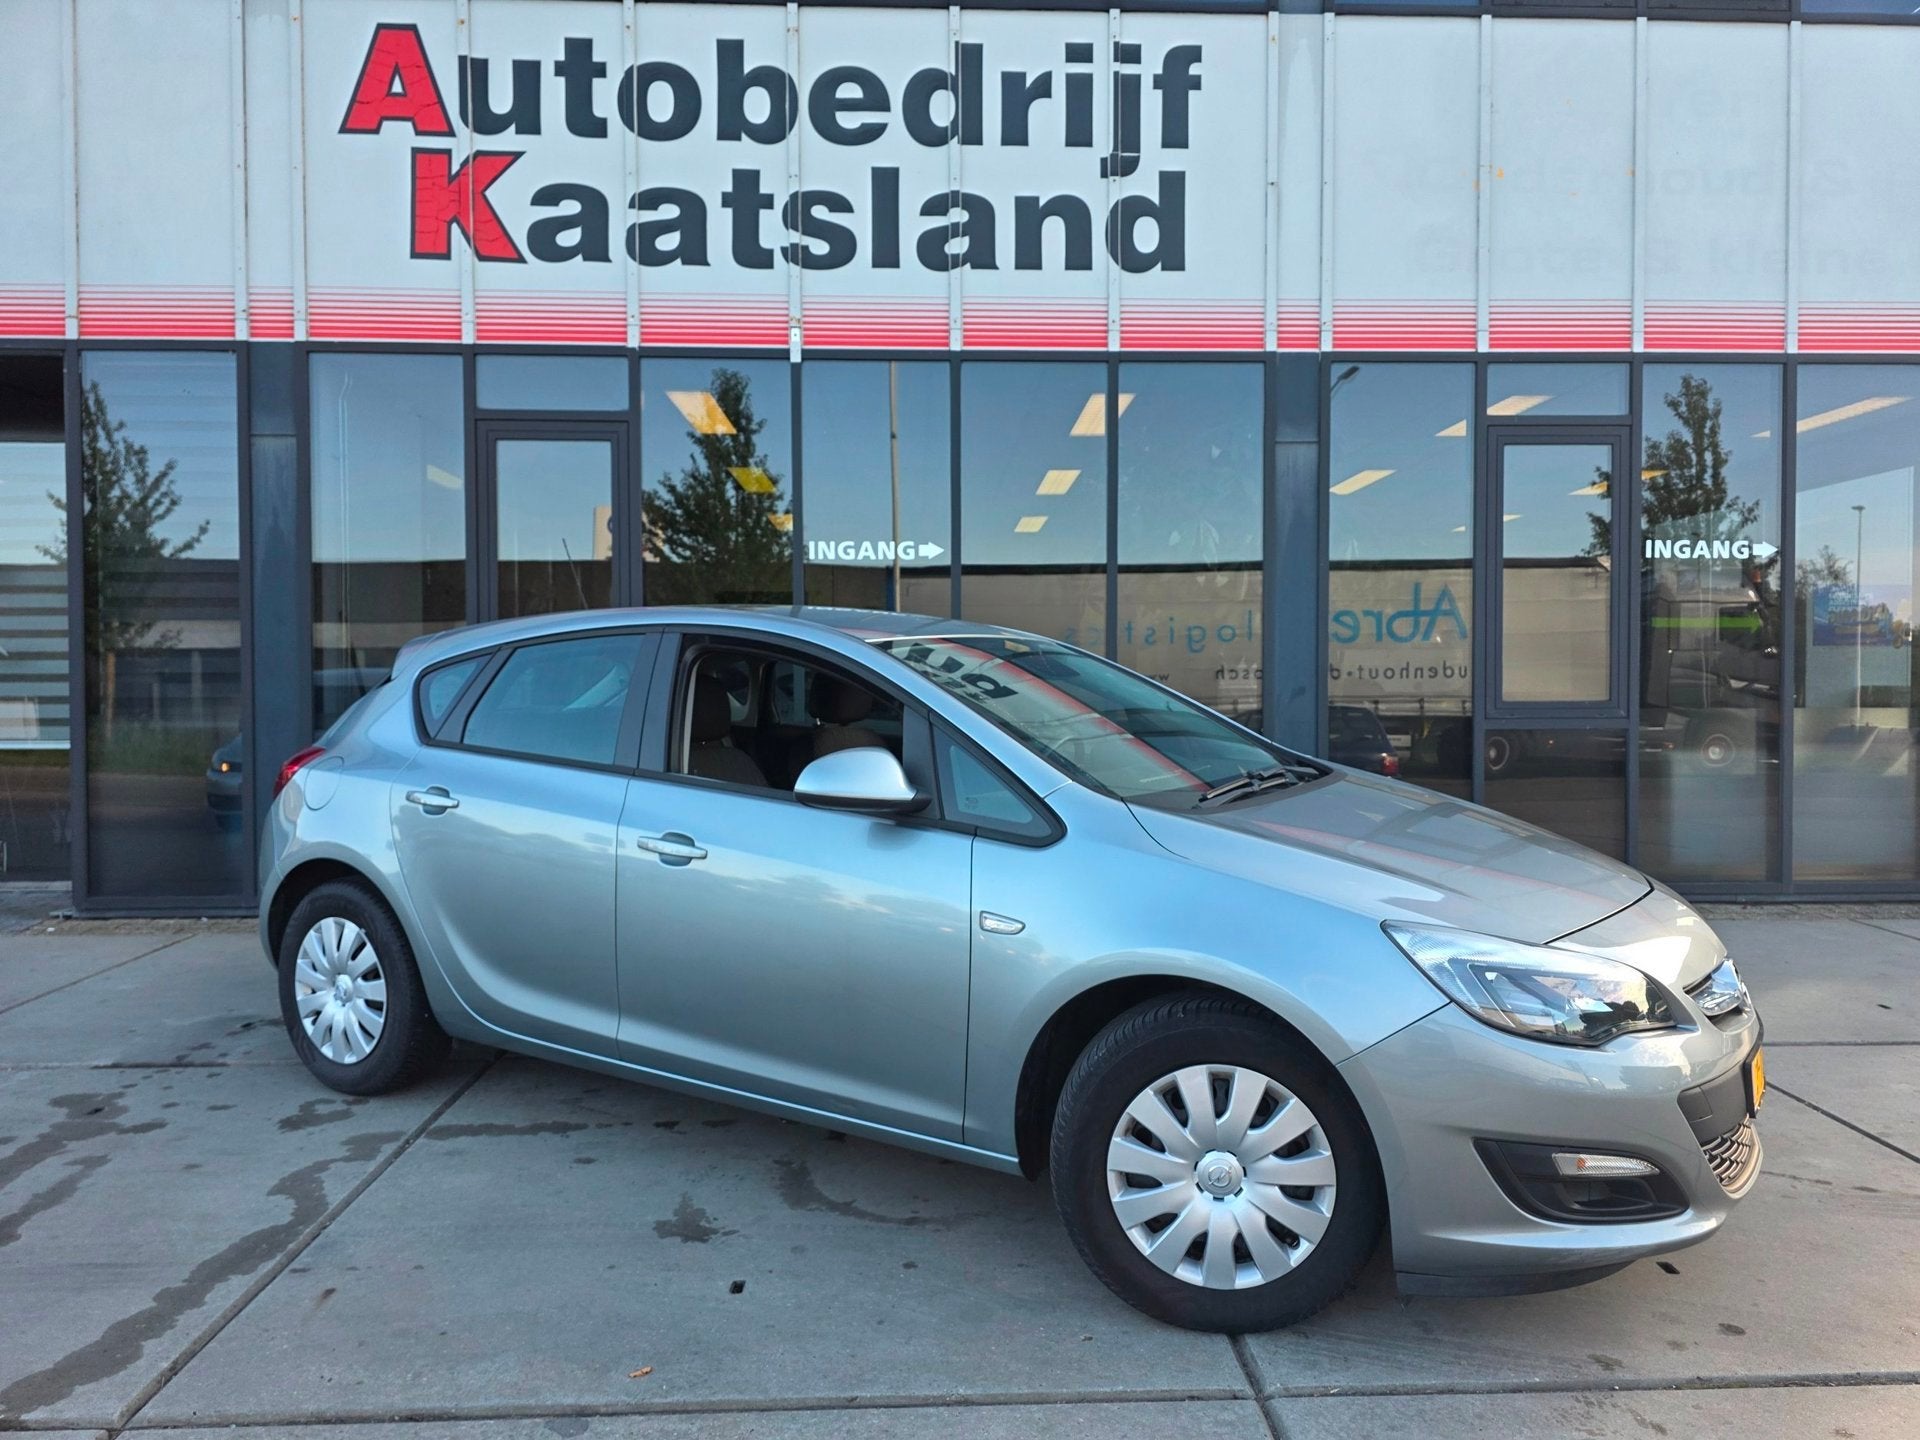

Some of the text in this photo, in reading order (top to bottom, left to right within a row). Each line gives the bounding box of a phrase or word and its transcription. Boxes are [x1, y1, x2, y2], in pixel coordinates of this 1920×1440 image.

[338, 22, 1203, 179] Autobedrijf
[409, 147, 1188, 273] Kaatsland
[808, 541, 915, 560] INGANG
[1645, 539, 1751, 560] INGANG
